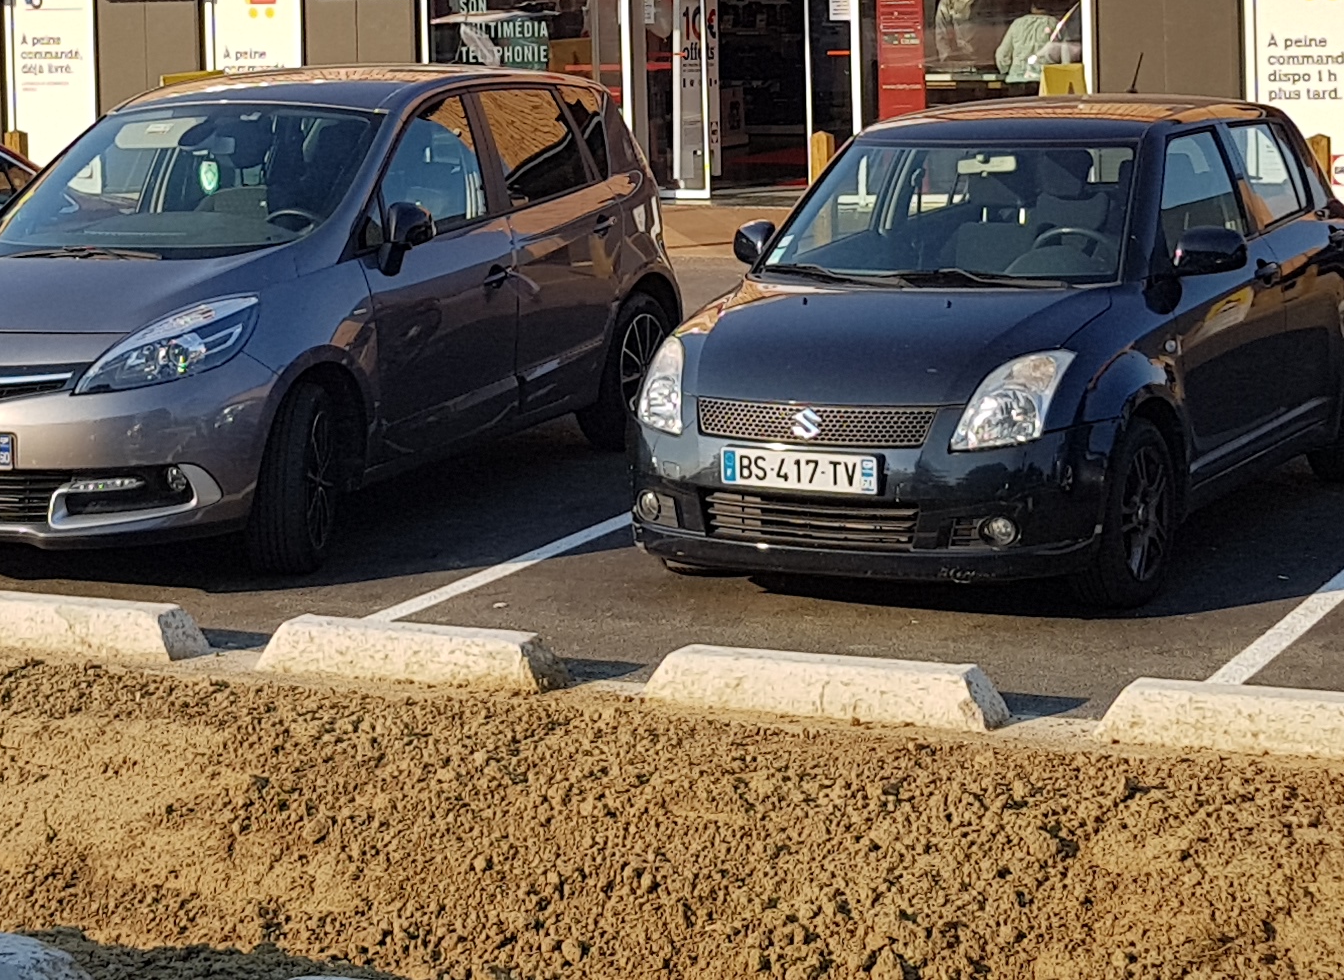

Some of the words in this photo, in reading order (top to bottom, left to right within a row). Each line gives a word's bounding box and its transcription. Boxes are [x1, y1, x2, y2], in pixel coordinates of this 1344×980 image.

[1267, 32, 1279, 47] À
[1284, 35, 1327, 50] peine
[1268, 69, 1311, 85] dispo
[1268, 88, 1301, 102] plus
[1306, 87, 1343, 100] tard.
[739, 454, 857, 487] BS-417-TV
